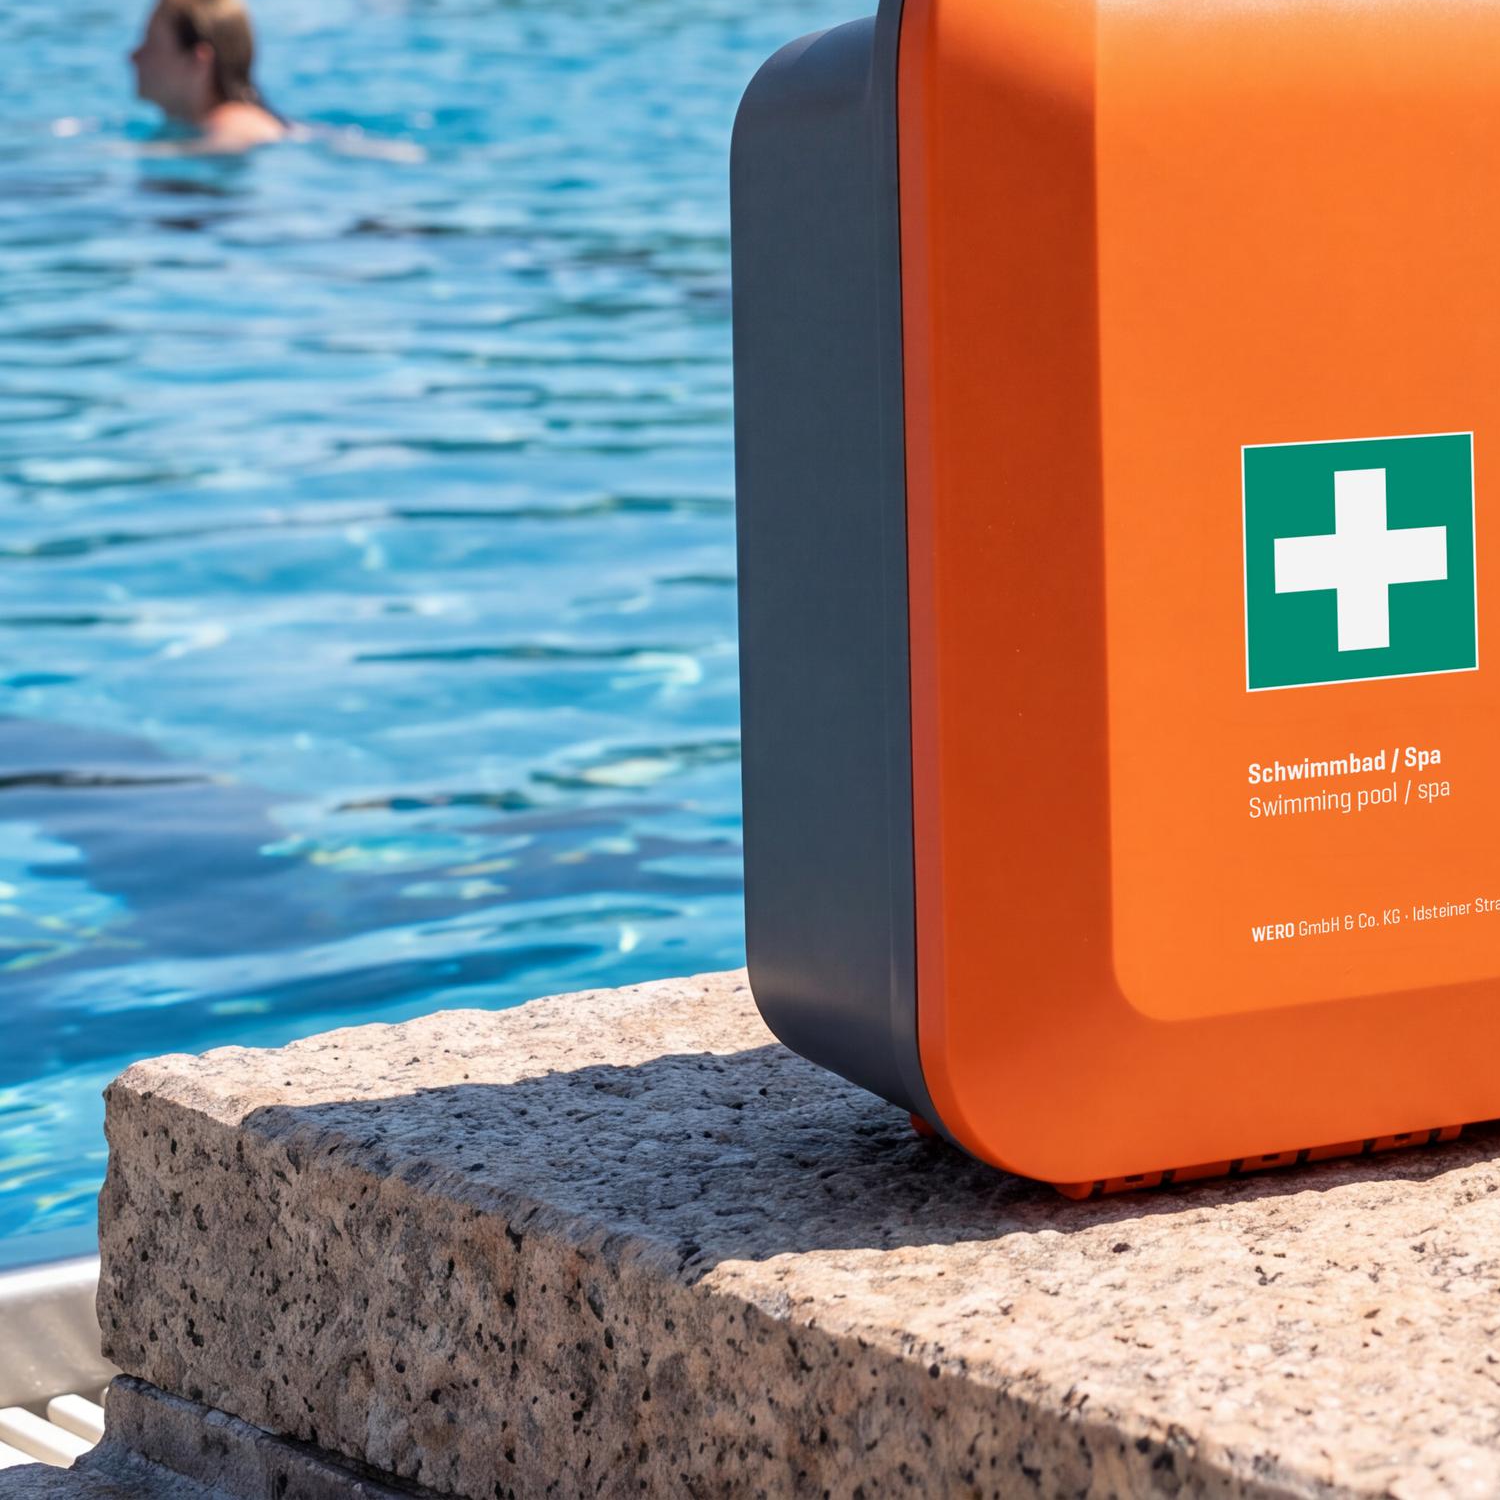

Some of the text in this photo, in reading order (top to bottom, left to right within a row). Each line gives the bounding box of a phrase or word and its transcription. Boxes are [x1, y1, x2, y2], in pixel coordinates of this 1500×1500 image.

[1247, 749, 1386, 785] Schwimmbad
[1404, 746, 1442, 772] Spa
[1249, 789, 1352, 819] Swimming
[1357, 781, 1398, 812] pool
[1417, 781, 1451, 804] spa
[1251, 922, 1295, 943] WERO
[1298, 916, 1340, 937] GmbH
[1344, 914, 1354, 931] &
[1358, 912, 1380, 929] Co.
[1383, 908, 1401, 925] KG
[1413, 902, 1472, 922] Idsteiner
